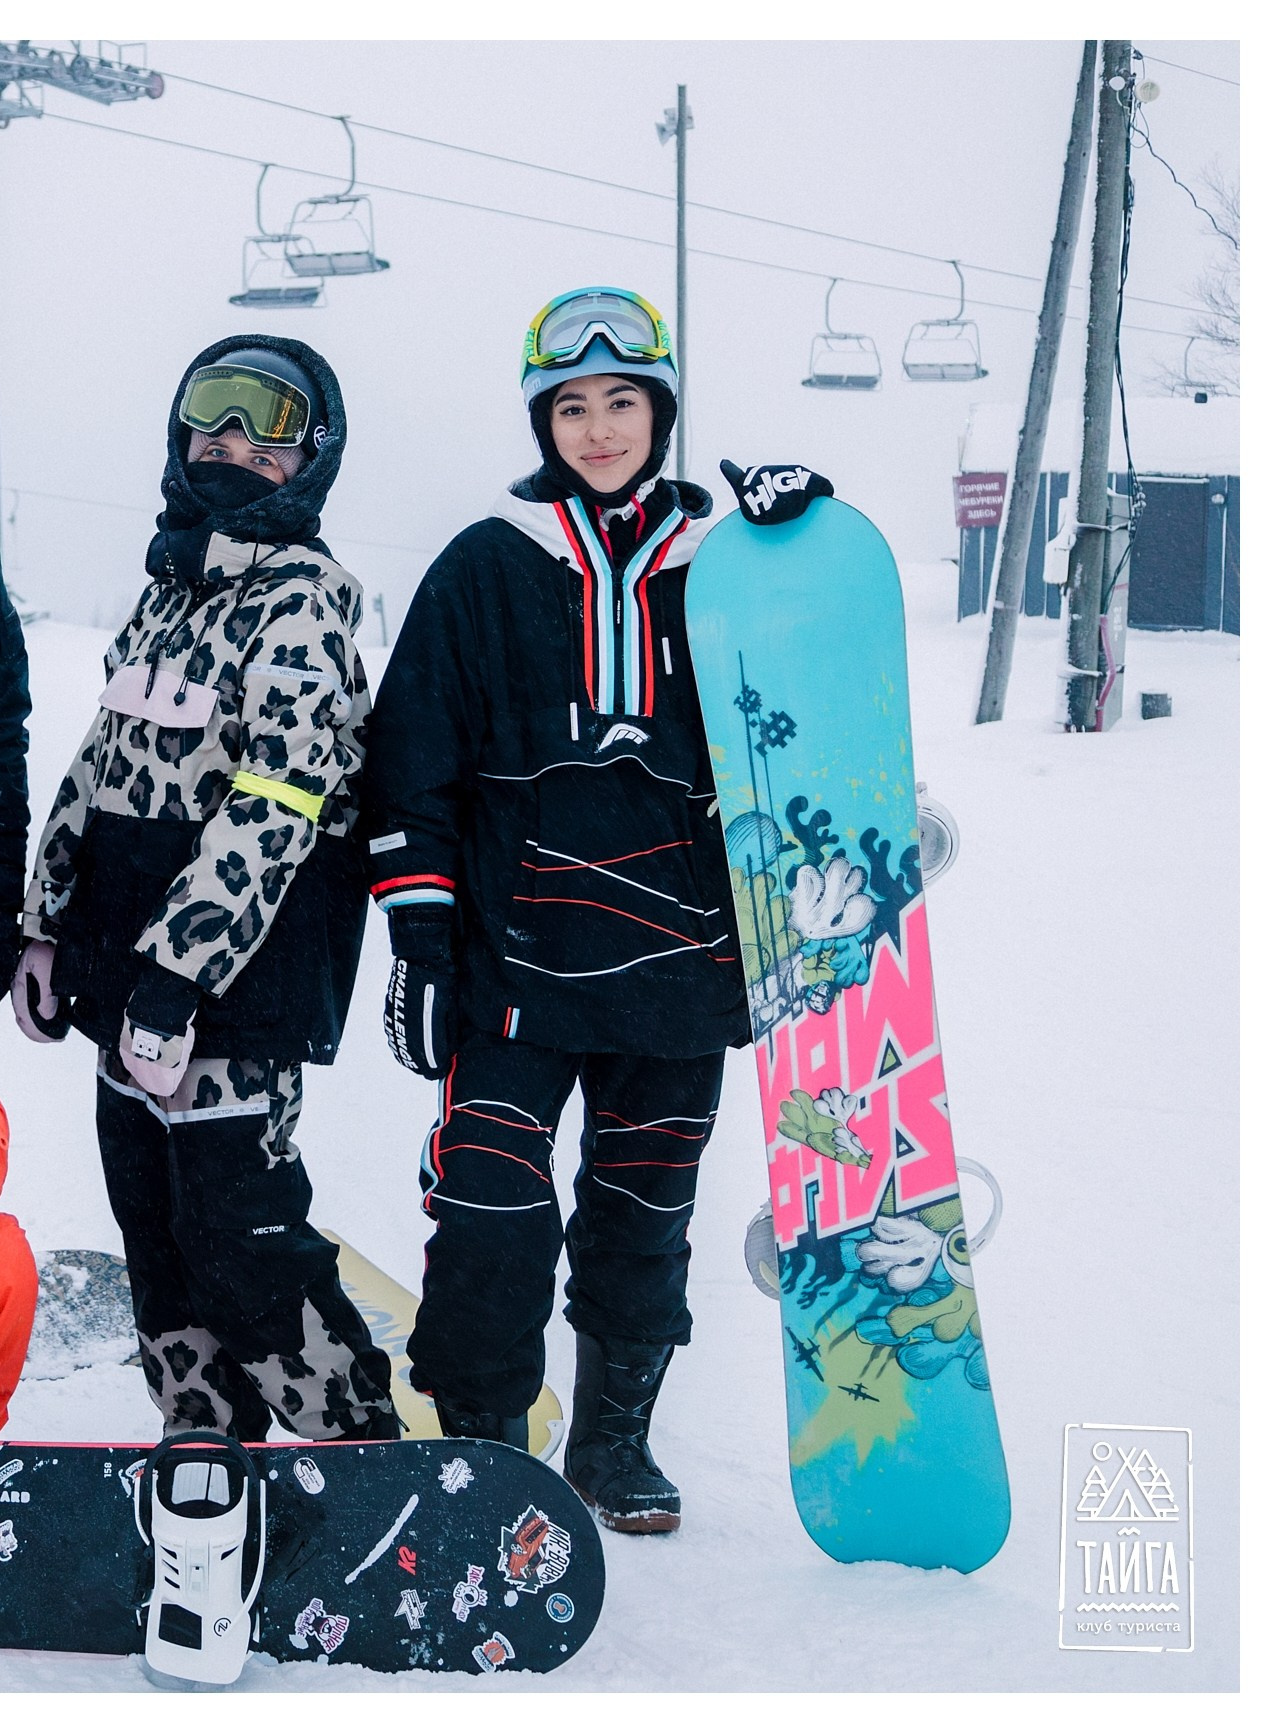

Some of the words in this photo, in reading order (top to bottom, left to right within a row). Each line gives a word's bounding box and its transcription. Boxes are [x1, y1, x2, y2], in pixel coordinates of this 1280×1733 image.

[959, 482, 1001, 493] ГОРЯЧИЕ
[959, 496, 1003, 506] ЧЕБУРЕКИ
[967, 508, 997, 519] ЗДЕСЬ
[394, 959, 420, 1070] CHALLENGE
[207, 1108, 234, 1116] VECTOR
[252, 1225, 285, 1235] VECTOR
[104, 1462, 112, 1478] 158
[397, 1546, 416, 1575] K2
[469, 1567, 483, 1585] TAKE
[322, 1616, 348, 1653] ПОЛНОЕ
